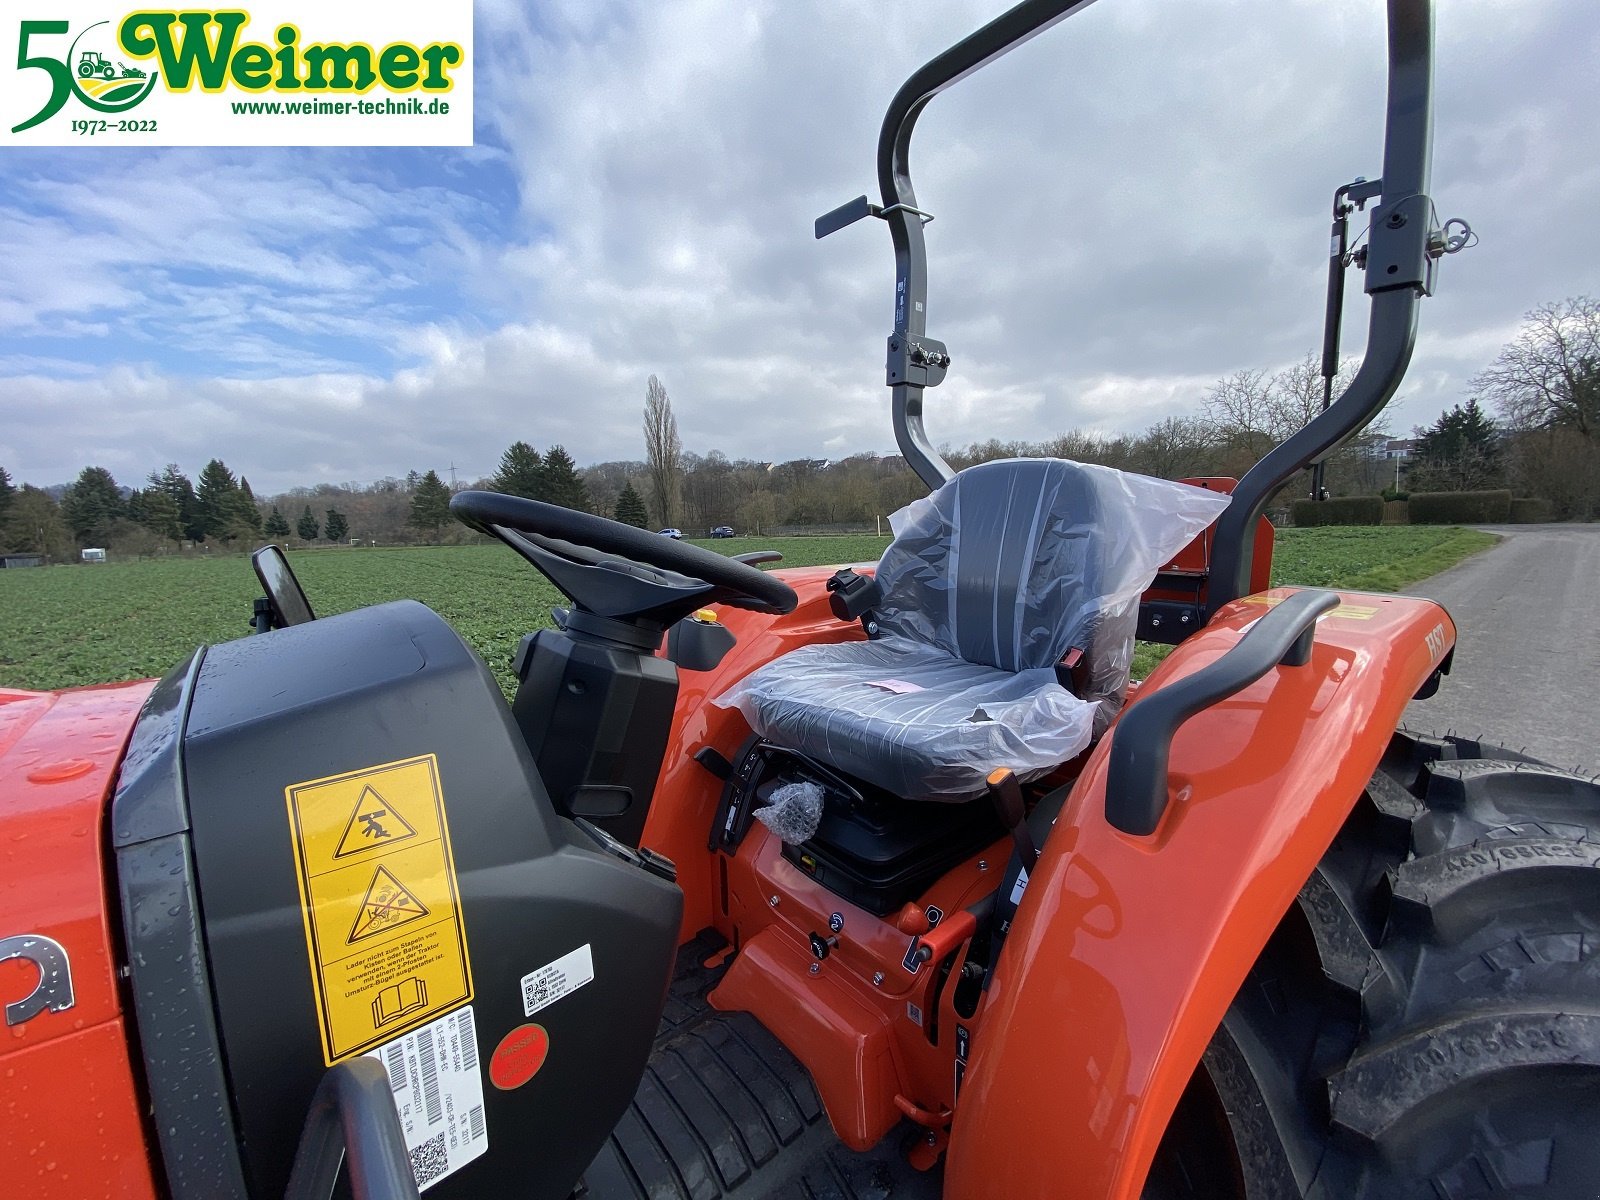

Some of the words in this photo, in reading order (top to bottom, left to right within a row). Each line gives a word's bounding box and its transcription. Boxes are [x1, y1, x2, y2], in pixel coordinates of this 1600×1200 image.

[1425, 623, 1446, 663] HST
[346, 959, 365, 970] Lader
[367, 951, 384, 962] nicht
[385, 946, 399, 955] zum
[400, 936, 424, 949] Stapeln
[425, 931, 437, 939] von
[347, 966, 386, 983] verwenden,
[387, 959, 405, 969] wenn
[406, 952, 417, 960] der
[418, 943, 440, 955] Traktor
[363, 975, 374, 984] mit
[375, 968, 396, 978] einem
[397, 955, 427, 970] 2-Pfosten
[364, 960, 386, 970] Kisten
[386, 952, 402, 962] oder
[403, 943, 423, 954] Ballen
[345, 974, 395, 998] Umsturz-Bügel
[396, 957, 434, 978] ausgestattet
[435, 953, 445, 961] ist.
